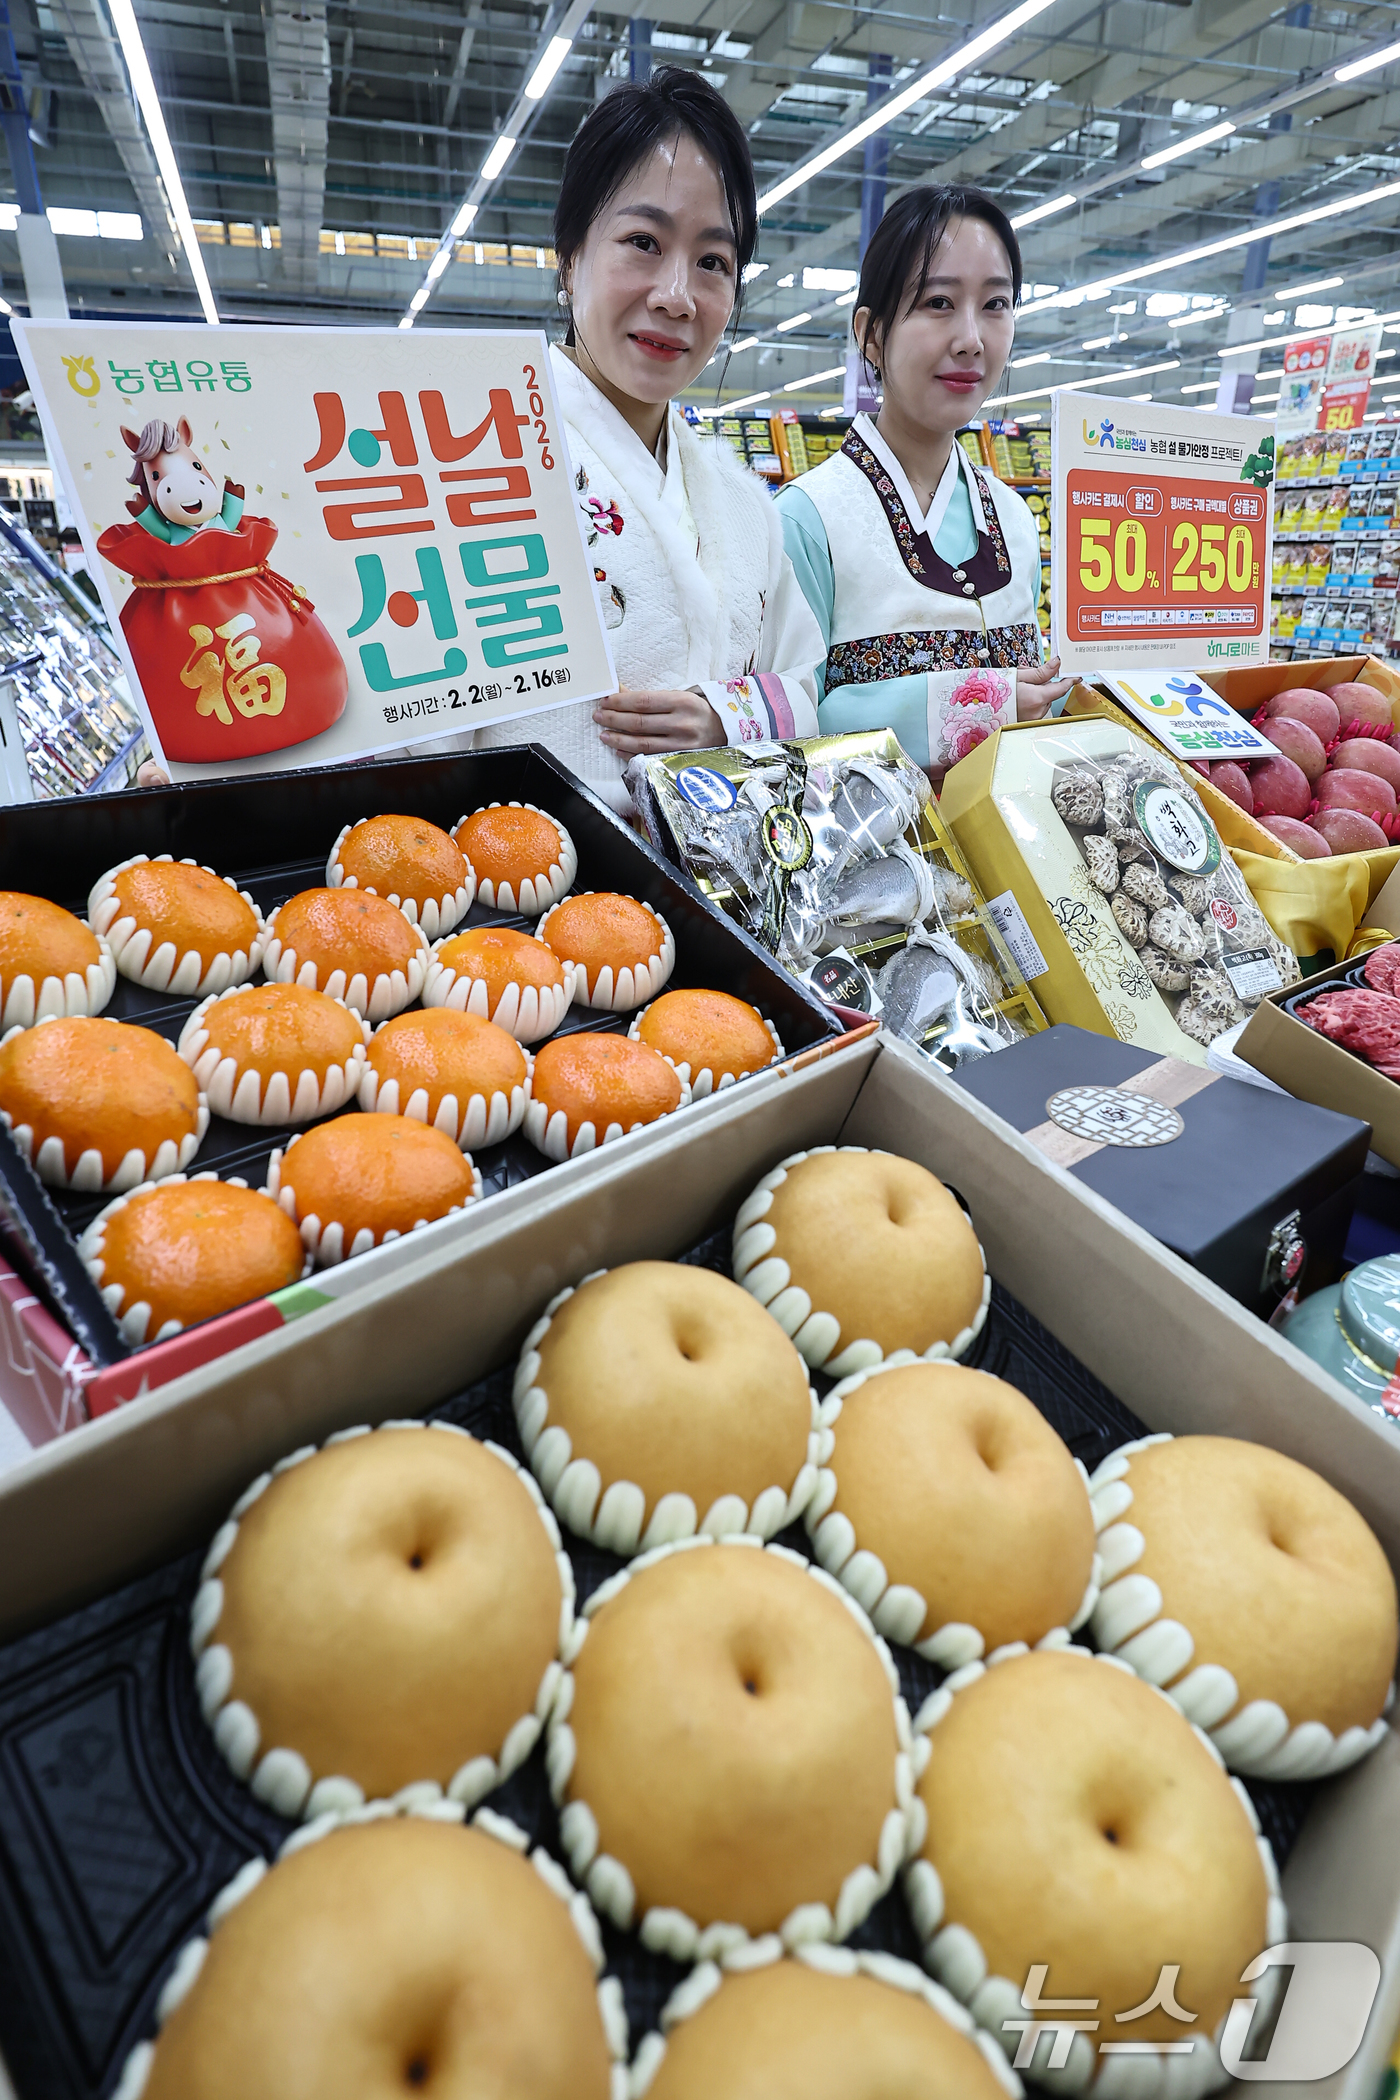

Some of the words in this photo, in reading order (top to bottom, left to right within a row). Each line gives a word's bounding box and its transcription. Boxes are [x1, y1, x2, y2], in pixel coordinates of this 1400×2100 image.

[108, 360, 252, 395] 농협유통
[522, 364, 556, 471] 2026
[1116, 436, 1147, 452] 농심천심
[1150, 439, 1167, 454] 농협
[1168, 441, 1177, 455] 설
[1178, 442, 1209, 459] 물가안정
[1211, 446, 1243, 462] 프로젝트!
[303, 388, 538, 541] 설날
[1072, 491, 1102, 506] 행사카드
[1103, 493, 1125, 508] 결제시
[1135, 493, 1154, 511] 할인
[1170, 496, 1193, 511] 행사카드
[1193, 498, 1205, 512] 구매
[1205, 500, 1227, 513] 금액대별
[1233, 498, 1258, 516] 상품권
[1126, 524, 1138, 534] 최대
[1235, 529, 1246, 539] 최대
[1172, 522, 1253, 593] 250
[346, 533, 570, 692] 선물
[1081, 614, 1101, 623] 행사카드
[1207, 640, 1260, 658] 하나로마트
[179, 612, 289, 726] 福
[382, 696, 440, 724] 행사기간
[1169, 720, 1198, 729] 국민과
[1195, 719, 1230, 728] 함께하는
[1169, 730, 1263, 749] 농심천심
[1158, 800, 1201, 858] 백화고
[827, 976, 861, 1001] 내산
